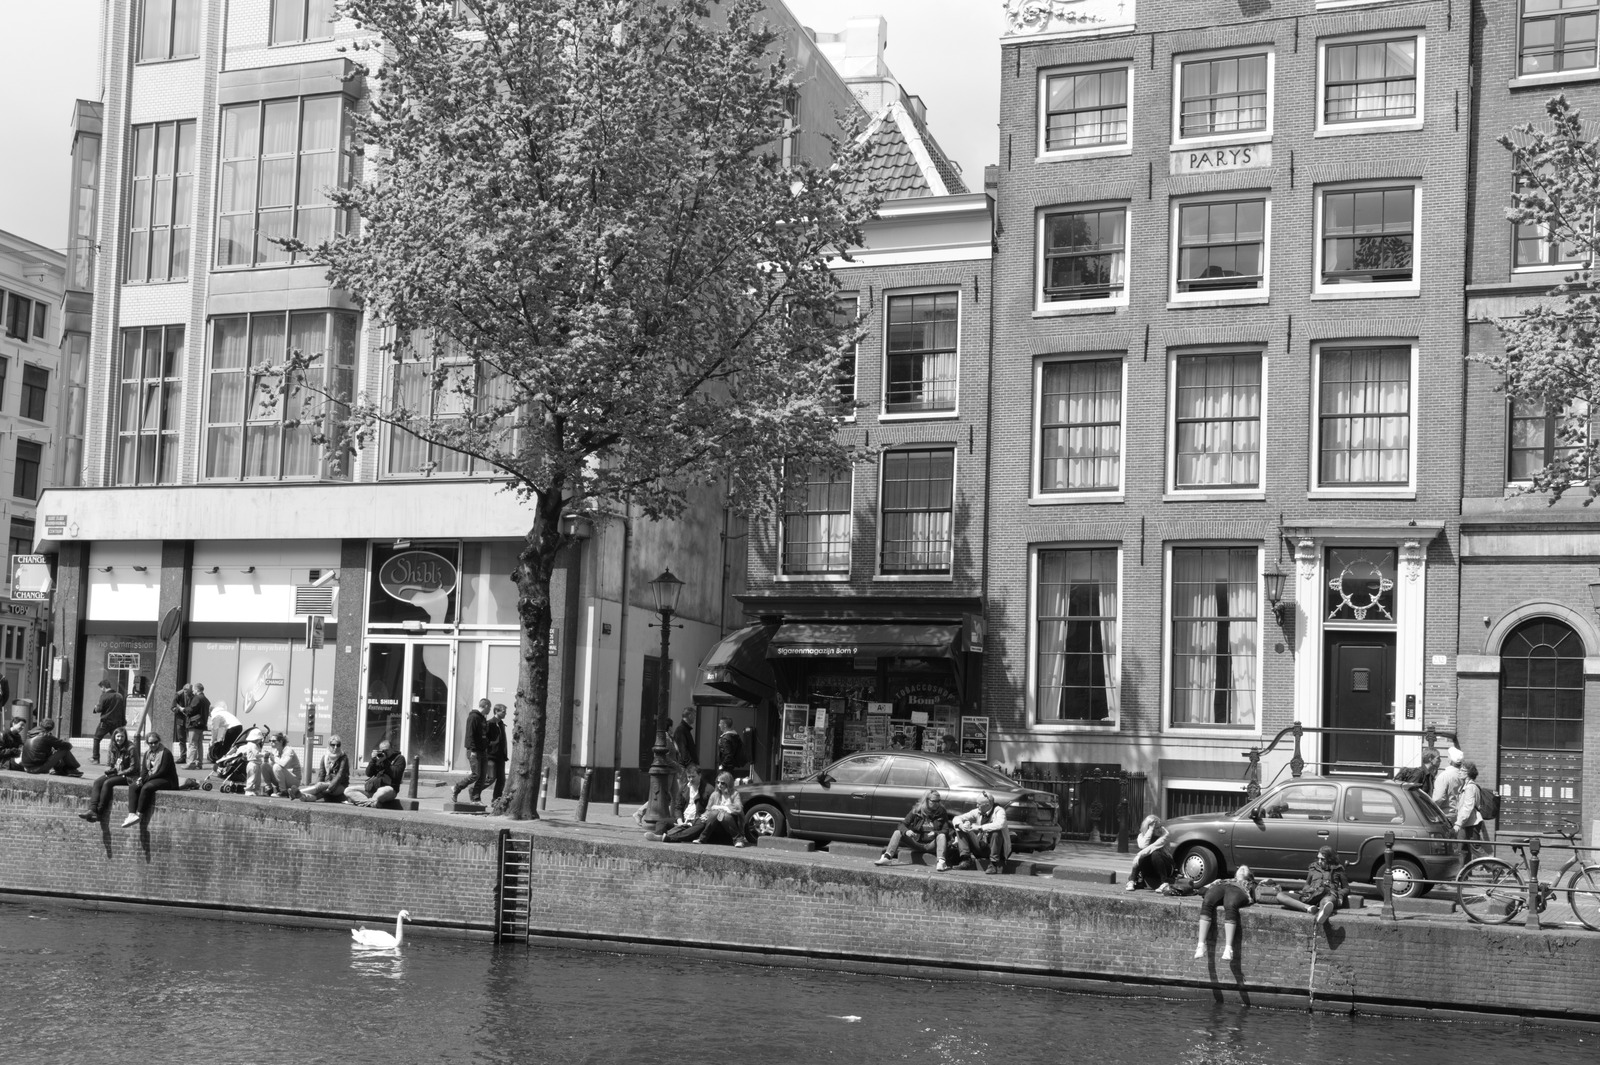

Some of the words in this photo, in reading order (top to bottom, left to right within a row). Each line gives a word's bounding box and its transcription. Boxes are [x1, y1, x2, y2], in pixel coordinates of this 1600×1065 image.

[1189, 147, 1251, 169] PARYS
[17, 556, 46, 564] CHANGE
[390, 557, 443, 590] Shibli
[16, 591, 45, 599] CHANGE
[110, 640, 154, 649] commission
[777, 647, 834, 656] Sigarenmagazijn
[304, 687, 318, 695] Chck
[895, 683, 955, 700] TOBACCOSHOP
[908, 695, 935, 705] Bom
